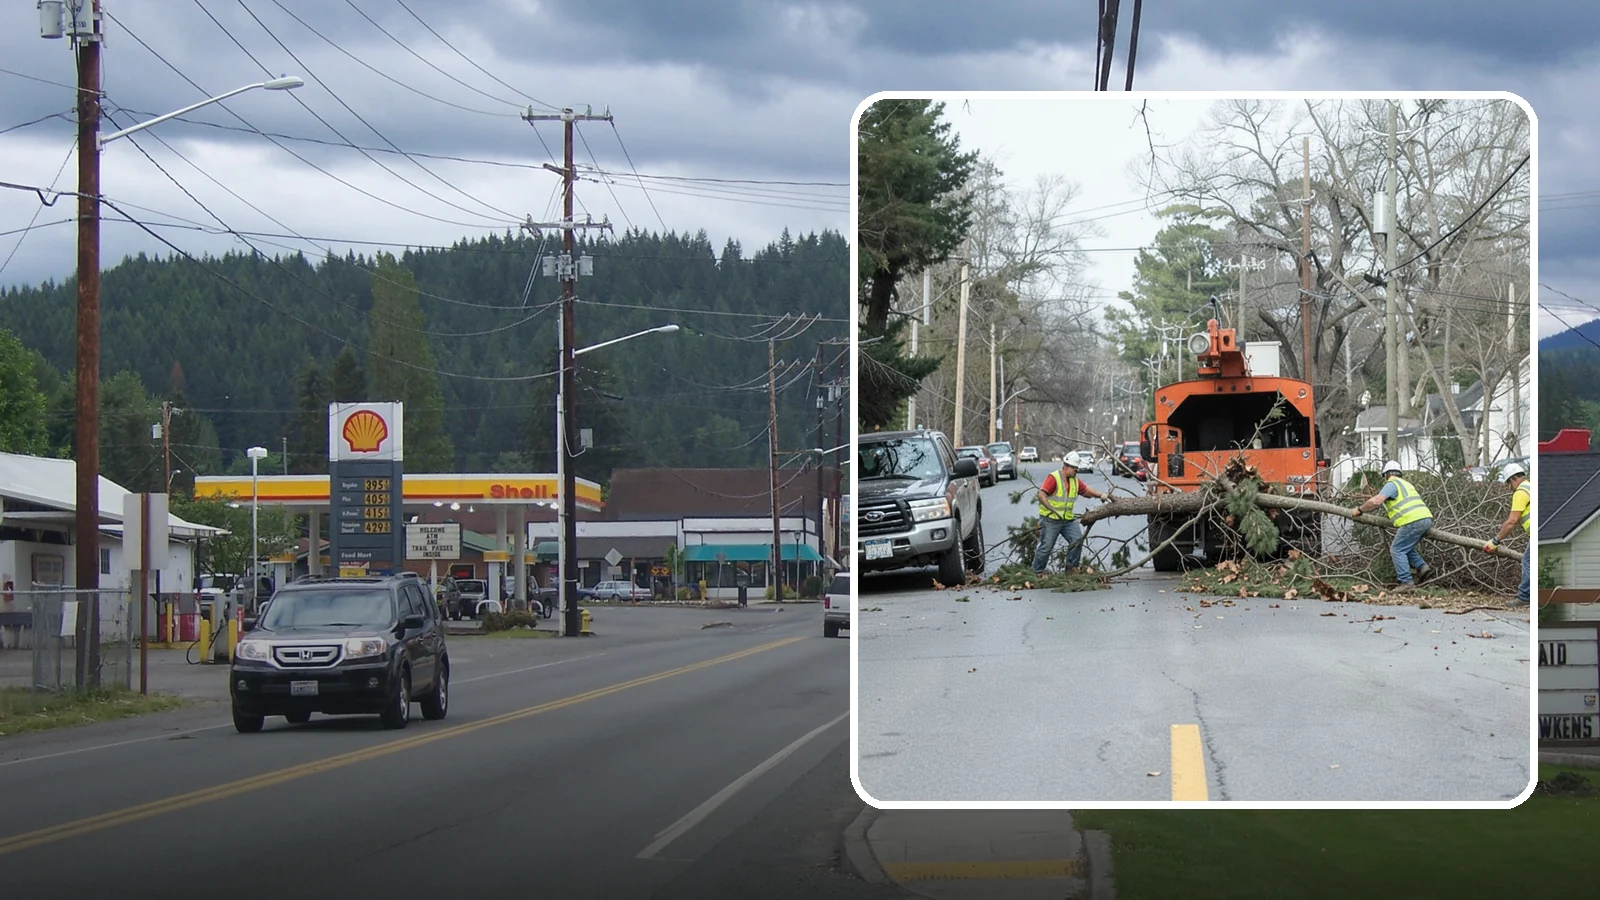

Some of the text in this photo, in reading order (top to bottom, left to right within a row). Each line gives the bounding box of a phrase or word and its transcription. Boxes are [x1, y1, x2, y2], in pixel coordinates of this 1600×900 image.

[366, 480, 383, 490] 395
[490, 484, 547, 499] Shell
[366, 494, 383, 504] 405
[366, 508, 383, 518] 415
[366, 522, 383, 532] 429
